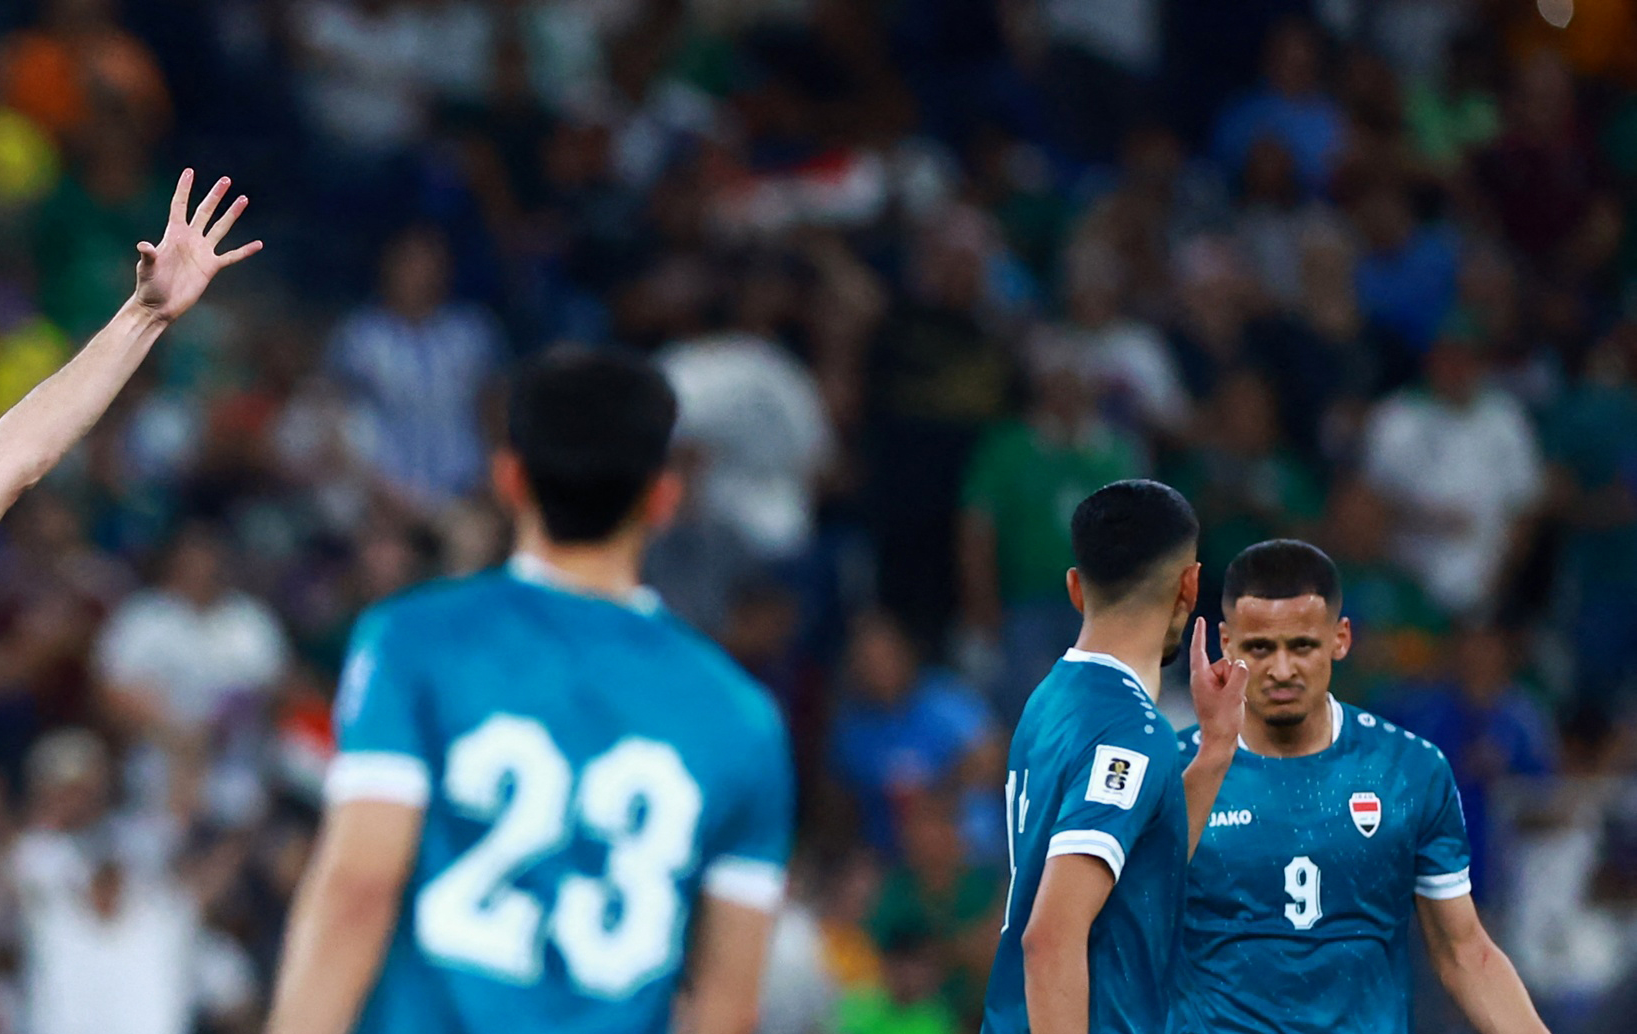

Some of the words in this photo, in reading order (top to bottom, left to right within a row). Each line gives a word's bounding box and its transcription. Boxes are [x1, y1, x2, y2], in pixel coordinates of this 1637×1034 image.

[412, 710, 703, 1000] 23
[1208, 809, 1252, 828] JAKO
[1284, 856, 1323, 930] 9
